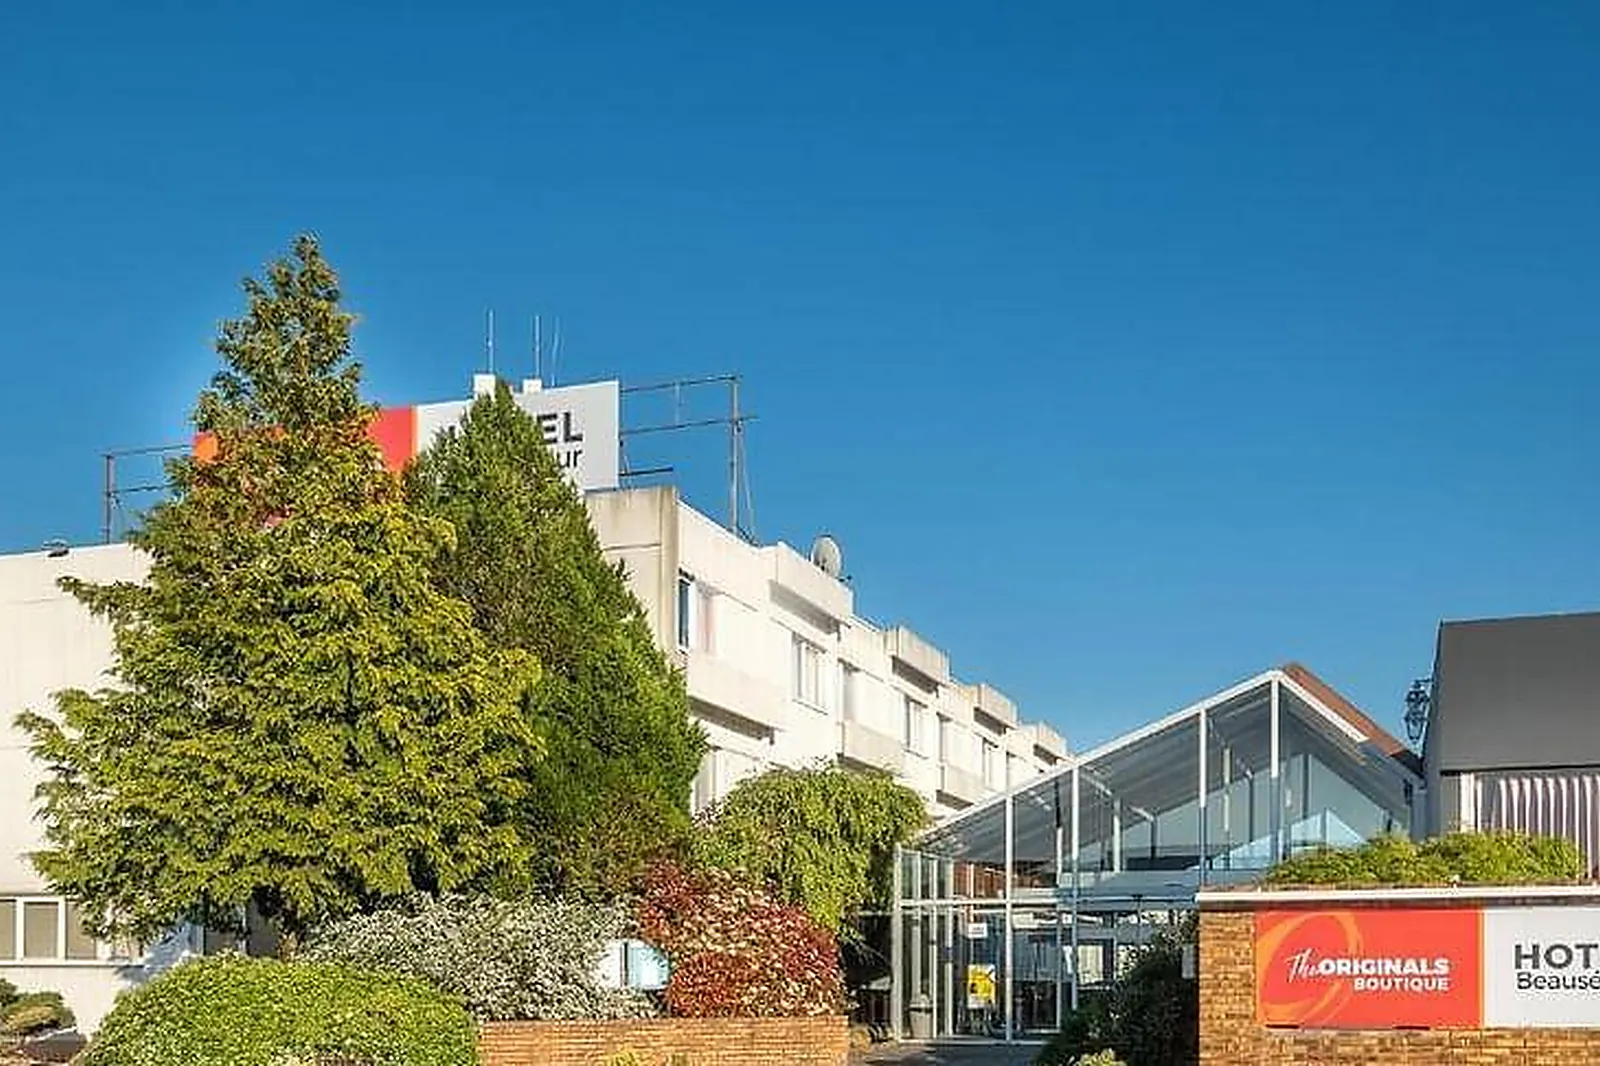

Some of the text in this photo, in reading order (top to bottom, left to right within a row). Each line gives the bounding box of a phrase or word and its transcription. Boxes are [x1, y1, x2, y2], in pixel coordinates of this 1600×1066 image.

[1285, 948, 1449, 983] The ORIGINALS
[1514, 943, 1599, 970] HOT
[1354, 977, 1450, 992] BOUTIQUE
